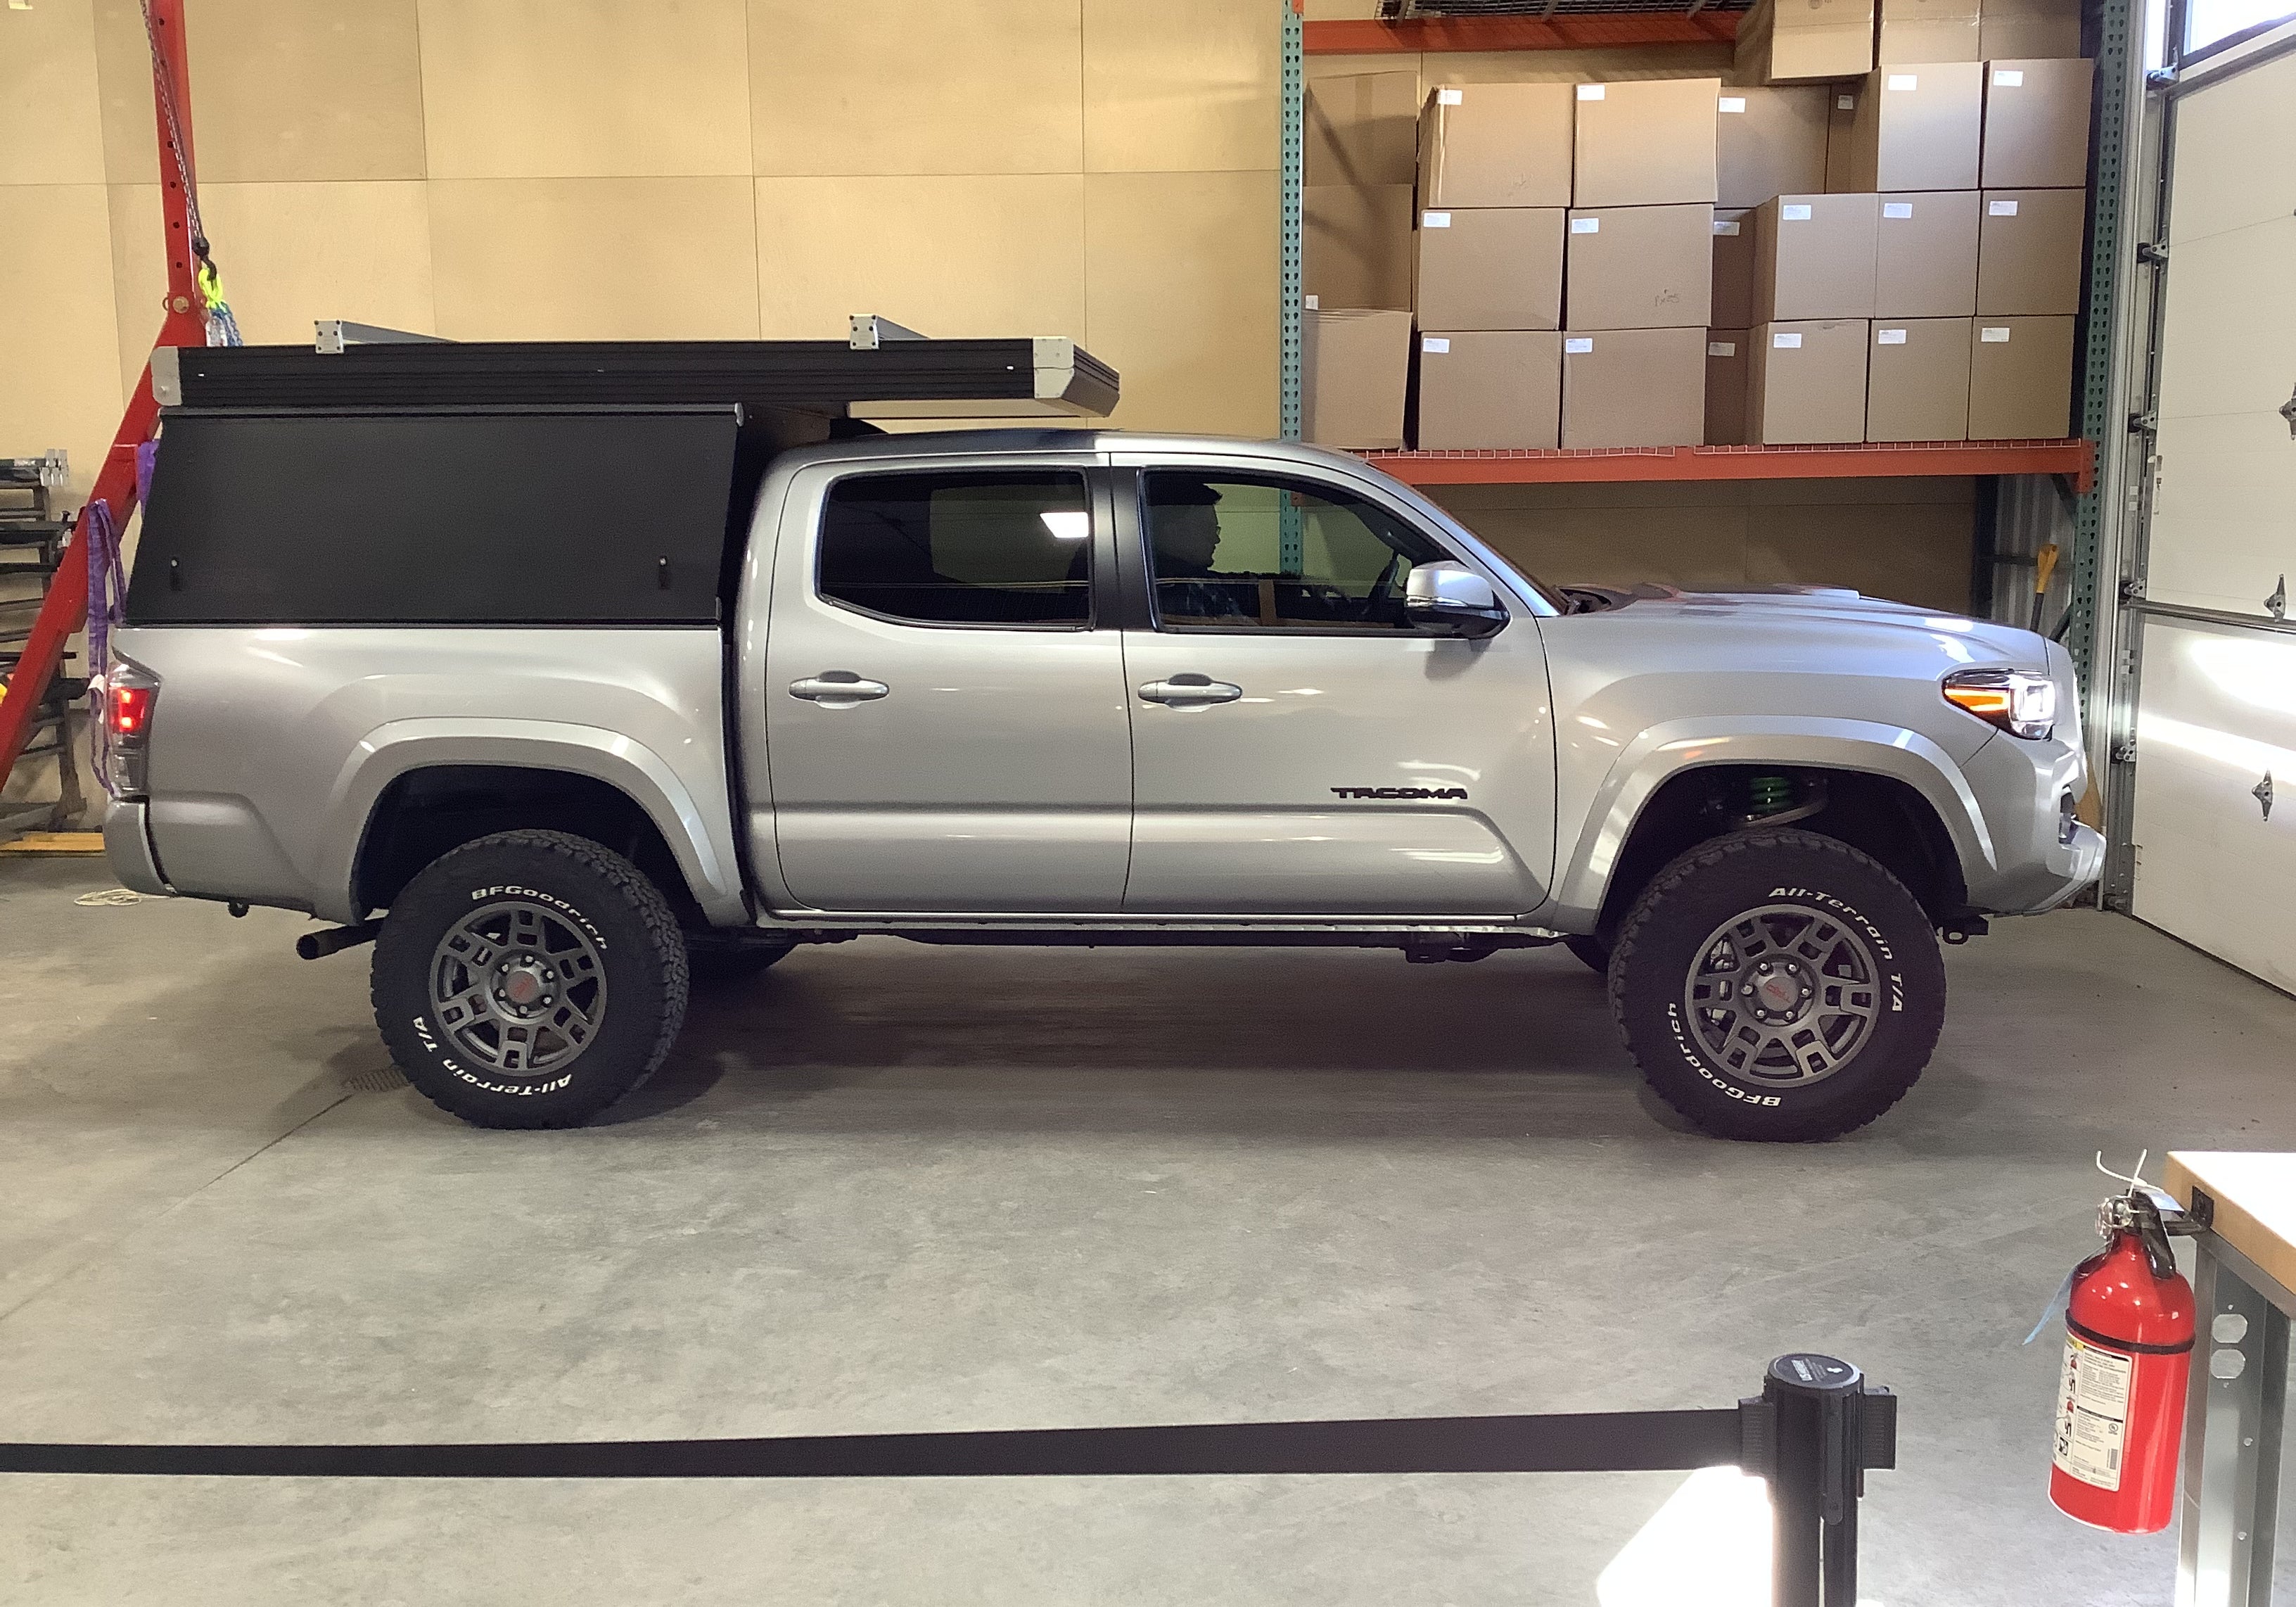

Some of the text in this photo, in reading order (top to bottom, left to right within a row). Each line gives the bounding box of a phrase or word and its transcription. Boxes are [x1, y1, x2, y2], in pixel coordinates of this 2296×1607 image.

[1329, 787, 1468, 800] TACOMA
[471, 885, 608, 950] BFGoodrich
[1768, 887, 1903, 1012] All-Terrain T/A
[412, 1016, 572, 1095] All-Terrain T/A
[1667, 1003, 1782, 1107] BFGoodrich
